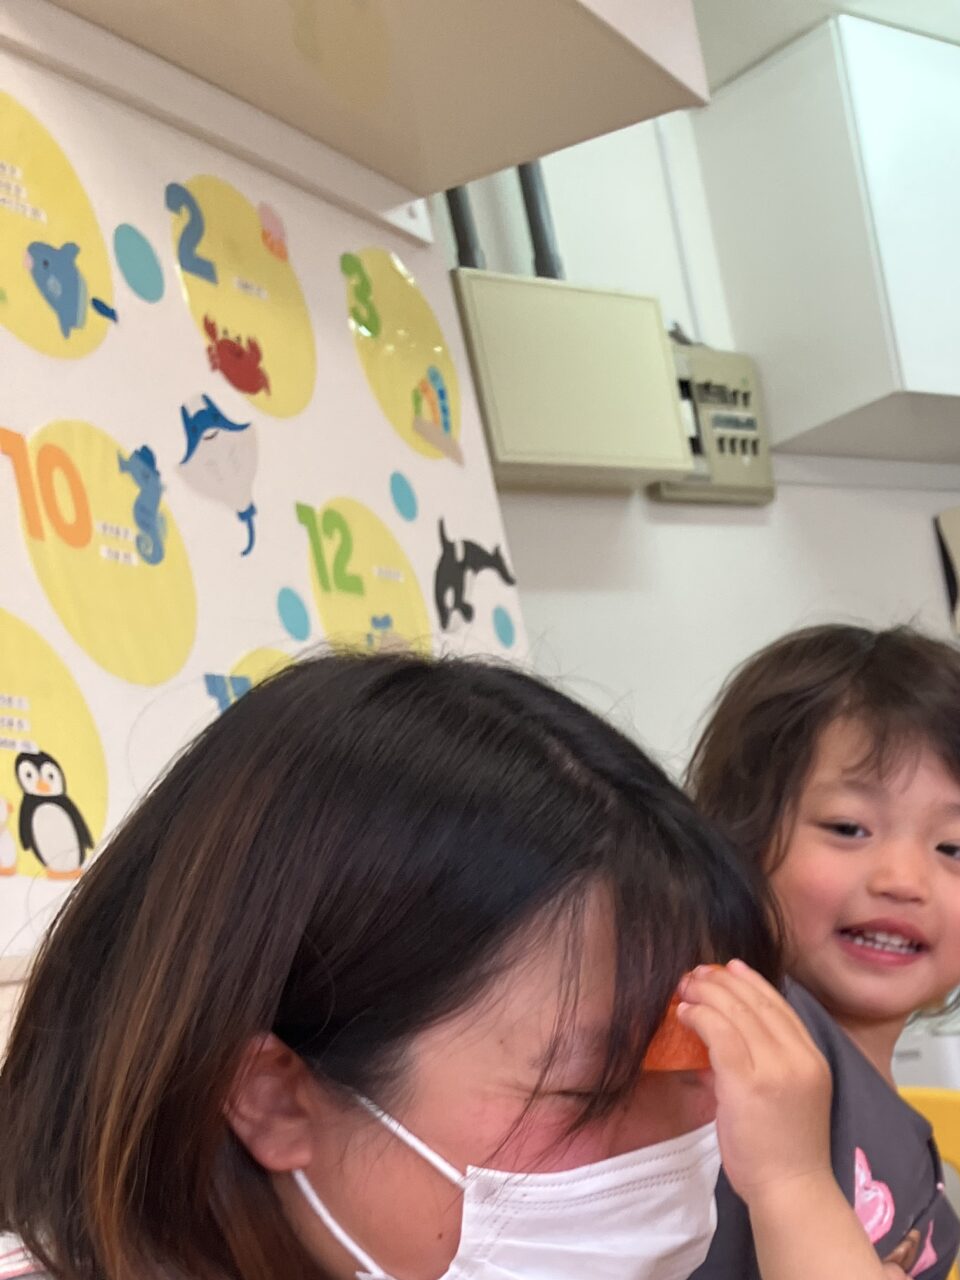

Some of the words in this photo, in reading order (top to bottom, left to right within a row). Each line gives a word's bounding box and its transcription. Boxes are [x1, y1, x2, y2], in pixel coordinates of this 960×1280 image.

[165, 183, 218, 285] 2
[340, 253, 381, 338] 3
[0, 427, 93, 549] 10
[295, 502, 366, 596] 12
